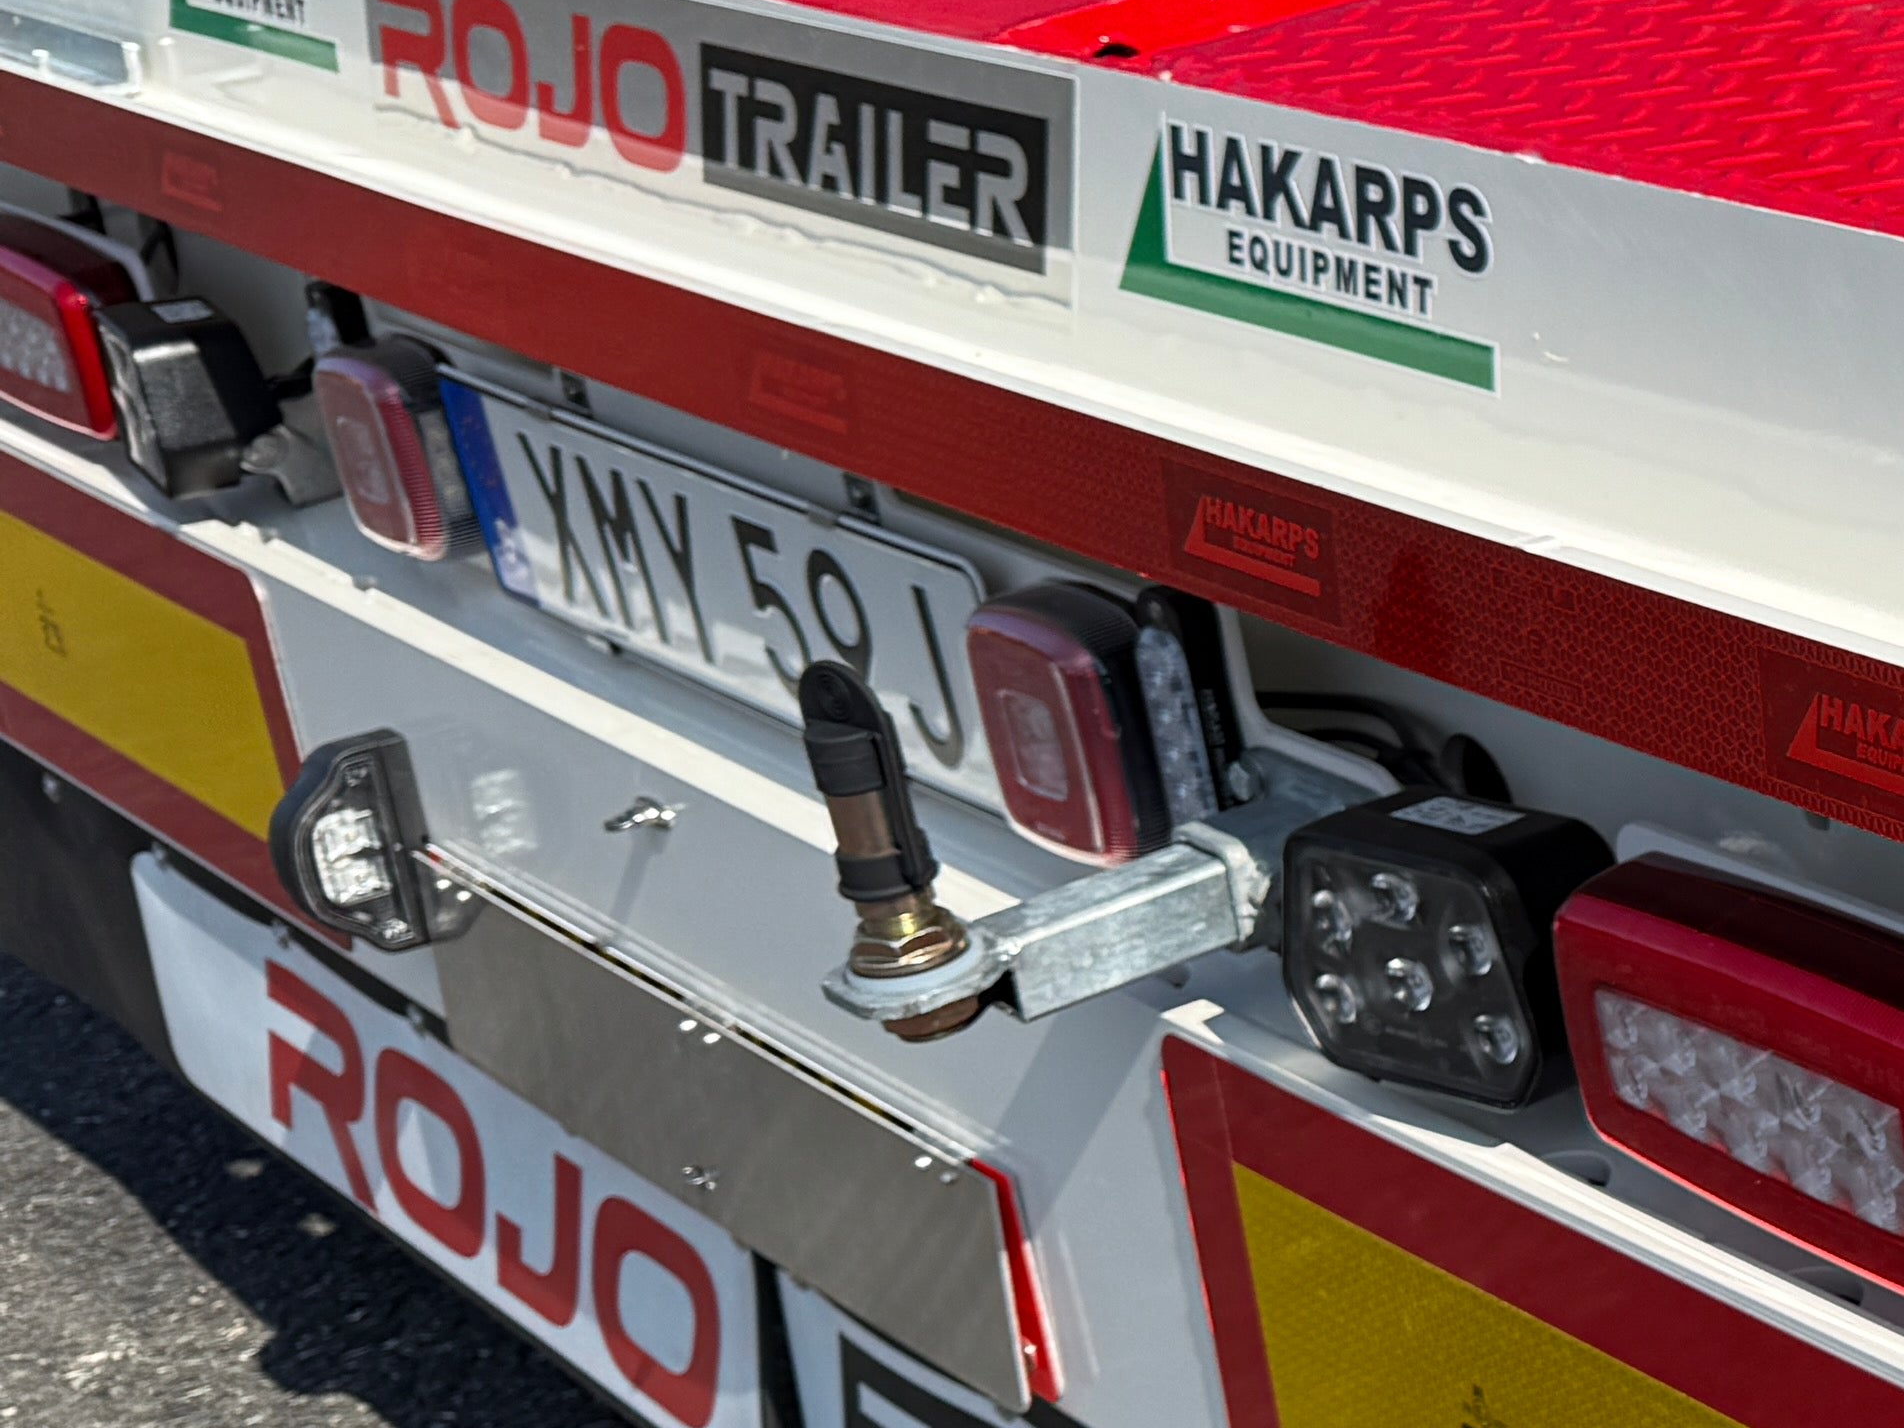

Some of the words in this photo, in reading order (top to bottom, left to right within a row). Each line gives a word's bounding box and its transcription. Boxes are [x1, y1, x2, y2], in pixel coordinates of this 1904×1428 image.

[709, 67, 1034, 246] TRAILER
[1169, 122, 1493, 274] HAKARPS
[1227, 229, 1437, 316] EQUIPMENT
[517, 432, 714, 665] XMY
[1206, 496, 1320, 560] HAKARPS
